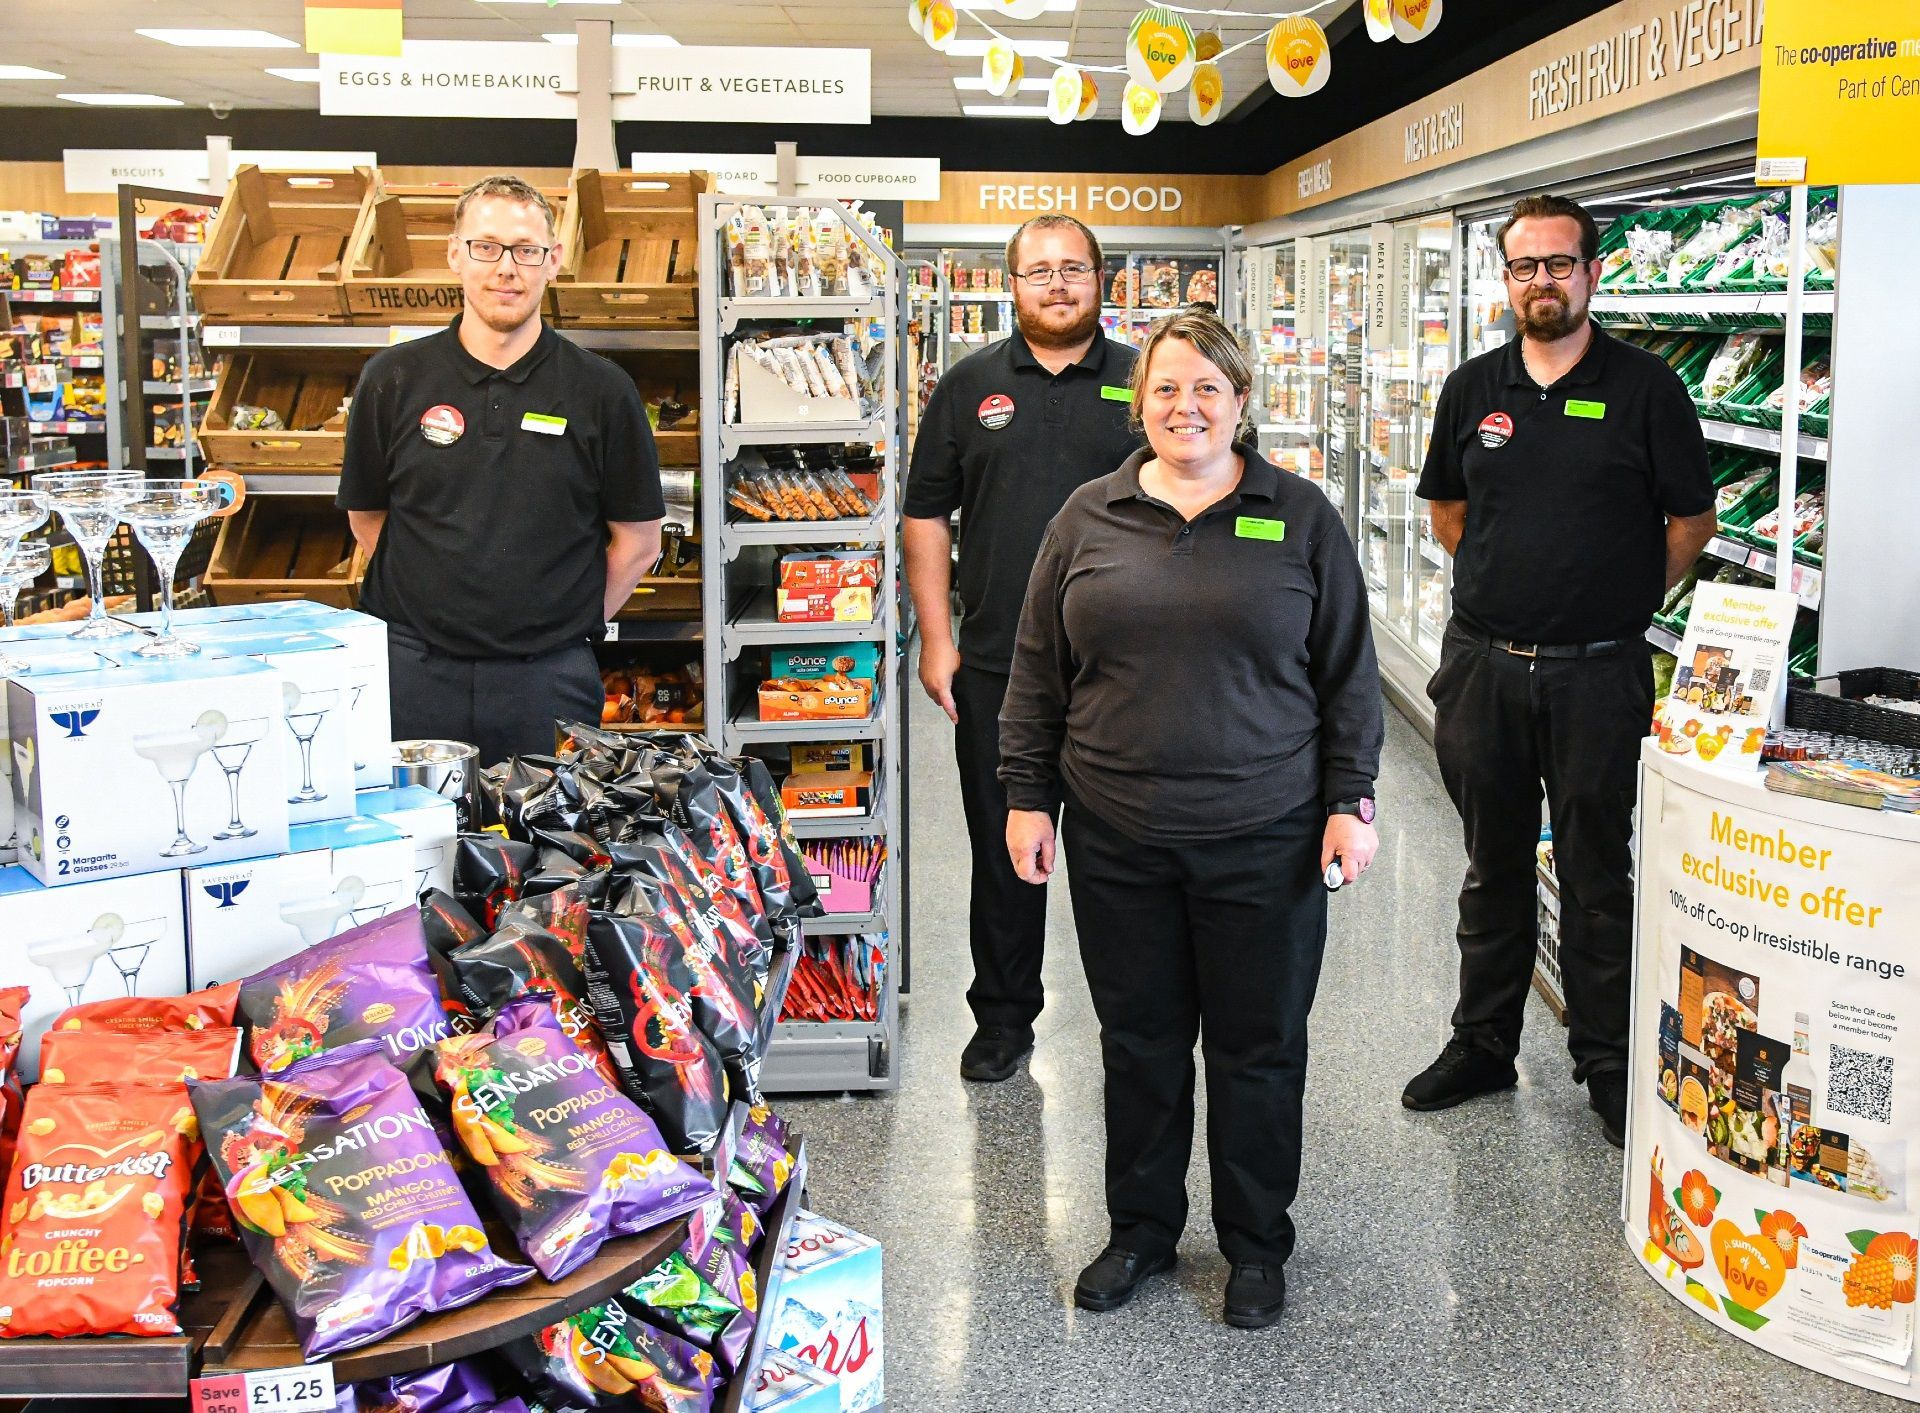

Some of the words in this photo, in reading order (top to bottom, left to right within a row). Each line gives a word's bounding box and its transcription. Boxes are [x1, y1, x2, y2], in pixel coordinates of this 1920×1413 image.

[1404, 0, 1428, 18] love
[1146, 44, 1176, 64] love
[1775, 45, 1797, 66] The
[1800, 37, 1897, 67] co-operative
[1286, 54, 1314, 71] love
[1529, 50, 1584, 121] FRESH
[1586, 23, 1646, 101] FRUIT
[1647, 17, 1667, 81] &
[339, 72, 392, 86] EGGS
[400, 73, 413, 87] &
[422, 73, 562, 89] HOMEBAKING
[637, 76, 693, 92] FRUIT
[700, 78, 712, 92] &
[719, 77, 844, 94] VEGETABLES
[1838, 78, 1868, 100] Part
[1872, 75, 1887, 98] of
[1404, 117, 1431, 164] MEAT
[1439, 102, 1464, 151] FISH
[111, 168, 165, 177] BISCUITS
[818, 173, 852, 183] FOOD
[855, 174, 917, 184] CUPBOARD
[979, 184, 1077, 211] FRESH
[1087, 186, 1183, 212] FOOD
[1377, 242, 1385, 270] MEAT
[1377, 272, 1384, 280] &
[366, 287, 405, 308] THE
[1376, 283, 1384, 329] CHICKEN
[980, 407, 1001, 417] UNDER
[1481, 423, 1500, 433] UNDER
[1722, 597, 1767, 612] Member
[1703, 610, 1751, 627] exclusive
[1753, 615, 1779, 630] offer
[1706, 627, 1714, 635] off
[1715, 628, 1733, 639] Co-op
[1733, 632, 1764, 643] Irresistible
[1763, 637, 1781, 646] range
[47, 701, 103, 712] RAVENHEAD
[1711, 811, 1832, 871] Member
[58, 859, 71, 876] 2
[73, 852, 117, 866] Margarita
[73, 863, 108, 875] Glasses
[201, 872, 253, 885] RAVENHEAD
[1681, 852, 1790, 908] exclusive
[1800, 886, 1883, 928] offer
[1669, 888, 1688, 914] 10%
[1690, 903, 1705, 922] off
[1707, 908, 1749, 942] Co-op
[1753, 924, 1840, 965] Irresistible
[1846, 954, 1905, 979] range
[1828, 1009, 1850, 1021] below
[1852, 1017, 1866, 1025] and
[1867, 1019, 1898, 1032] become
[1831, 1001, 1849, 1011] Scan
[1850, 1005, 1862, 1014] the
[1863, 1007, 1876, 1016] QR
[1876, 1011, 1896, 1021] code
[382, 1020, 448, 1056] IONS
[1838, 1023, 1869, 1036] member
[1871, 1031, 1893, 1043] today
[457, 1053, 597, 1123] SENSATION
[529, 1086, 617, 1130] POPPADO
[568, 1107, 625, 1138] MANGO
[567, 1137, 587, 1151] RED
[585, 1126, 611, 1142] CHILLI
[22, 1151, 173, 1191] Butterkist
[366, 1179, 434, 1206] MANGO
[437, 1178, 446, 1187] &
[361, 1207, 384, 1220] RED
[384, 1195, 417, 1212] CHILLI
[416, 1186, 459, 1202] CHUTNEY
[45, 1228, 102, 1240] CRUNCHY
[7, 1238, 130, 1279] toffee
[704, 1246, 724, 1275] LIME
[1723, 1240, 1732, 1249] A
[1731, 1239, 1771, 1270] summer
[1740, 1257, 1750, 1271] of
[1811, 1248, 1849, 1264] co-operative
[464, 1263, 494, 1278] 82.5g
[1724, 1255, 1769, 1297] love
[37, 1276, 94, 1288] POPCORN
[201, 1387, 240, 1401] Save
[254, 1379, 323, 1404] £1.25
